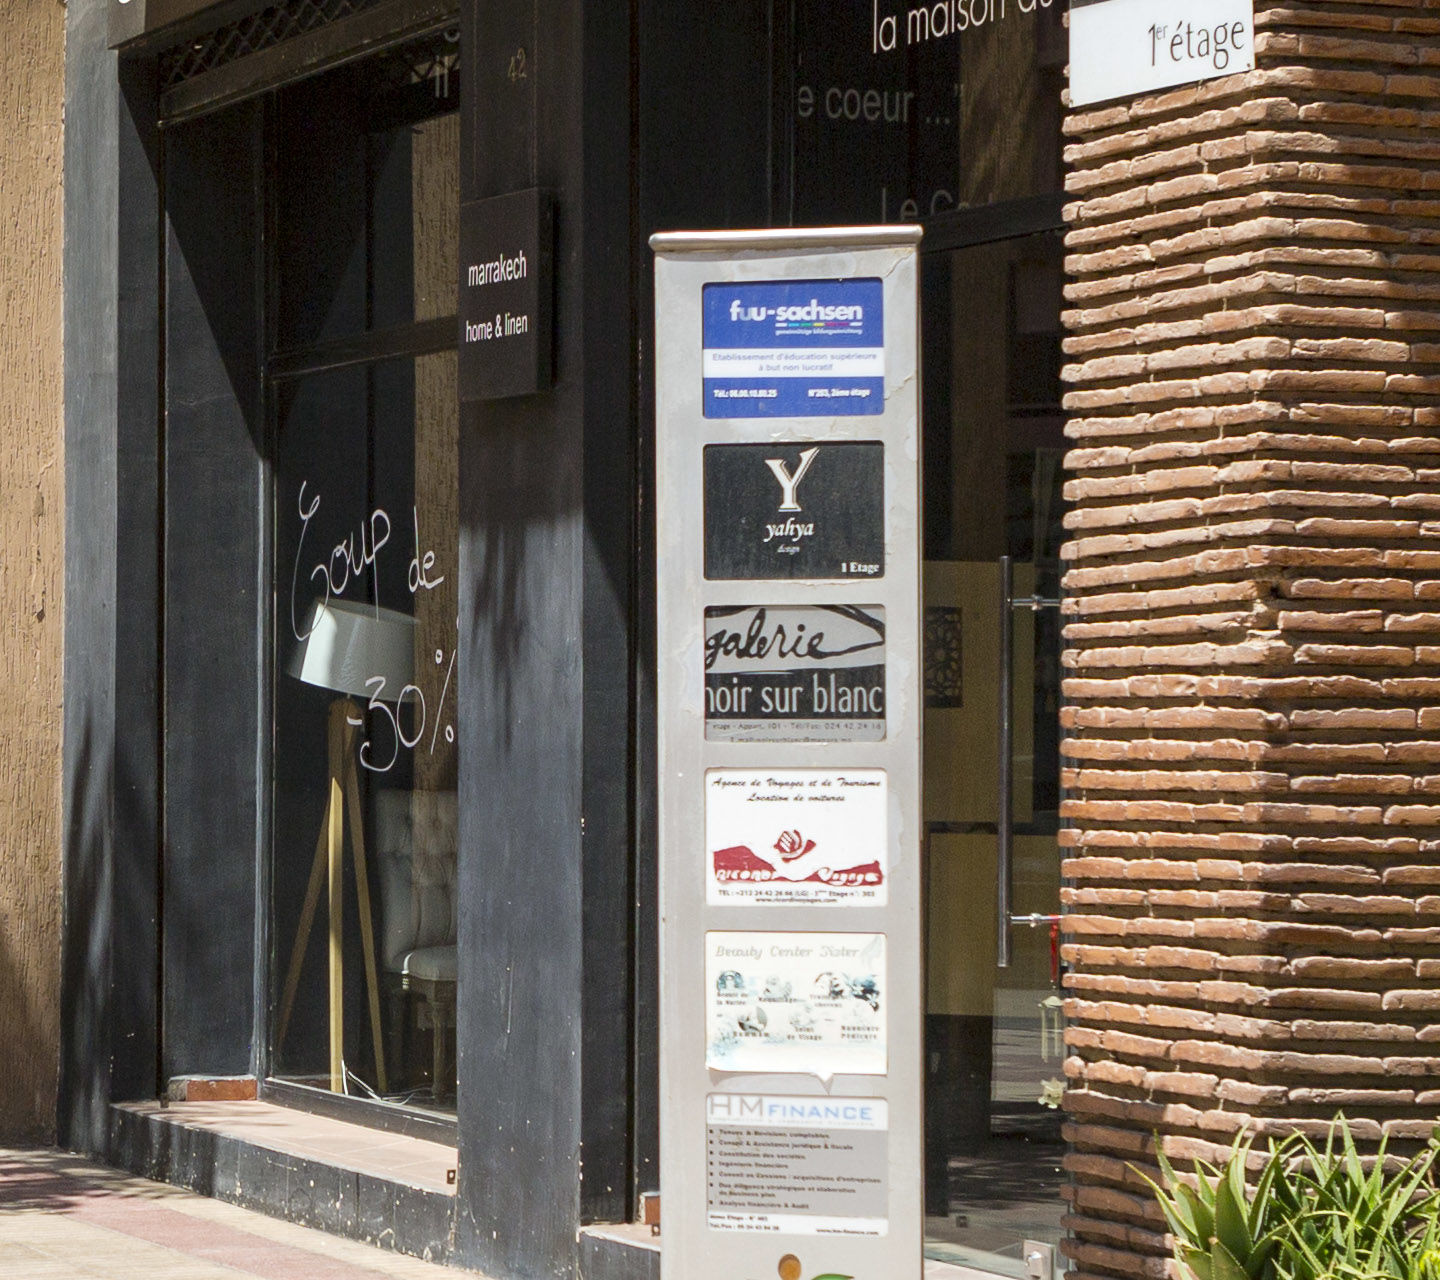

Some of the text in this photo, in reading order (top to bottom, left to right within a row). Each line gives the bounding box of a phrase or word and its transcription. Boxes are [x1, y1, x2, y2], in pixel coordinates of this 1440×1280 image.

[1170, 19, 1244, 69] étage
[825, 87, 914, 122] coeur
[468, 250, 527, 287] marrakech
[466, 312, 528, 342] home & linen
[765, 446, 820, 512] Y
[408, 505, 444, 592] de
[763, 517, 814, 542] yahya
[849, 562, 880, 574] Etage
[705, 607, 848, 669] galerie
[761, 685, 803, 712] sur
[813, 673, 883, 712] blanc
